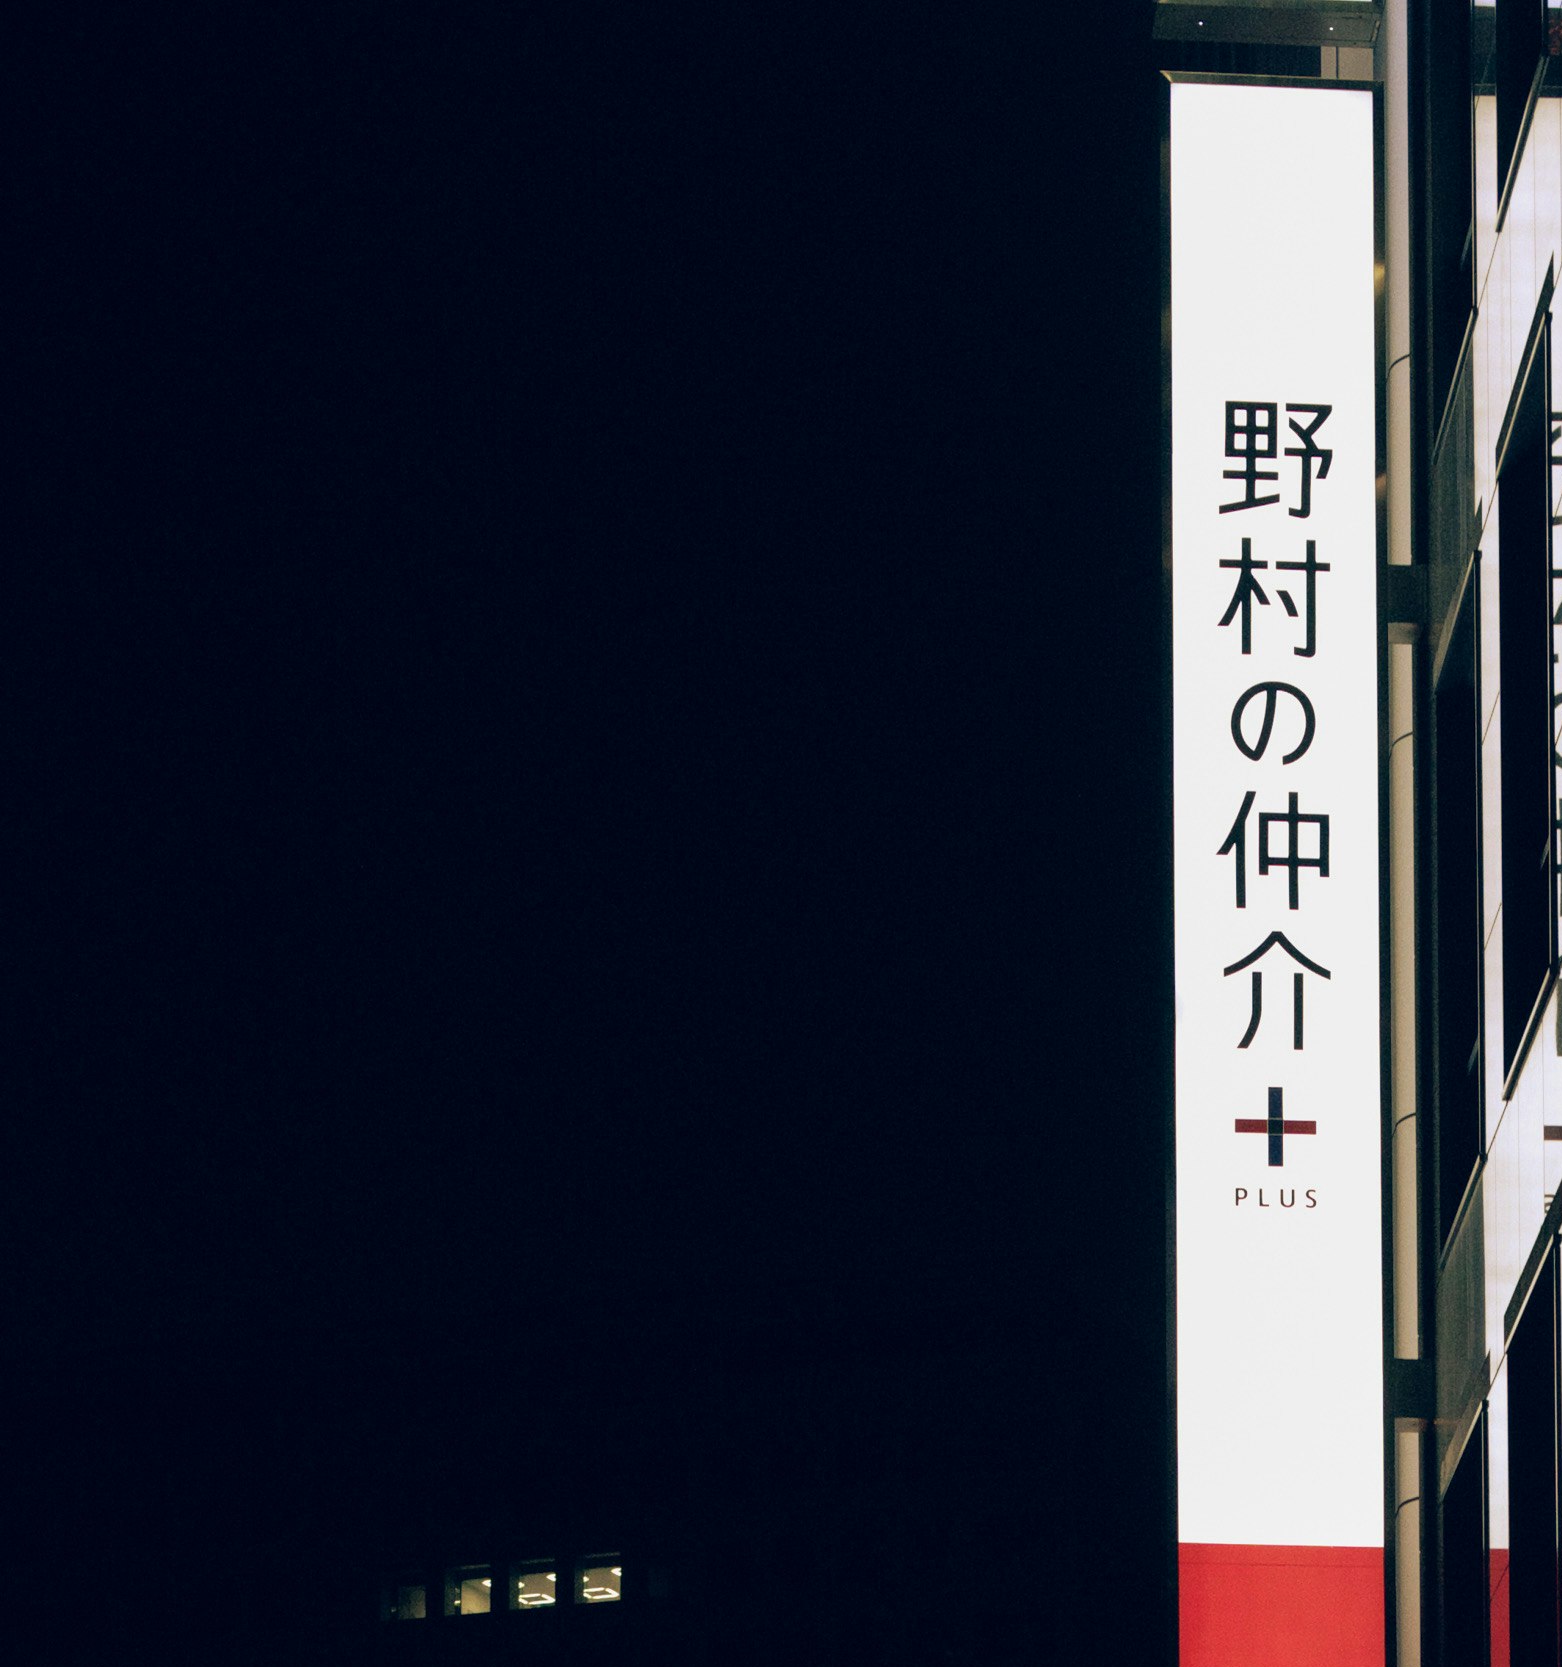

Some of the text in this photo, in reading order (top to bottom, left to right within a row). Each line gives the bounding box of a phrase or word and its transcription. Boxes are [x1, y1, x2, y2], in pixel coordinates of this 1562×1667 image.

[1217, 401, 1332, 1051] 野村の仲介
[1235, 1187, 1318, 1208] PLUS
